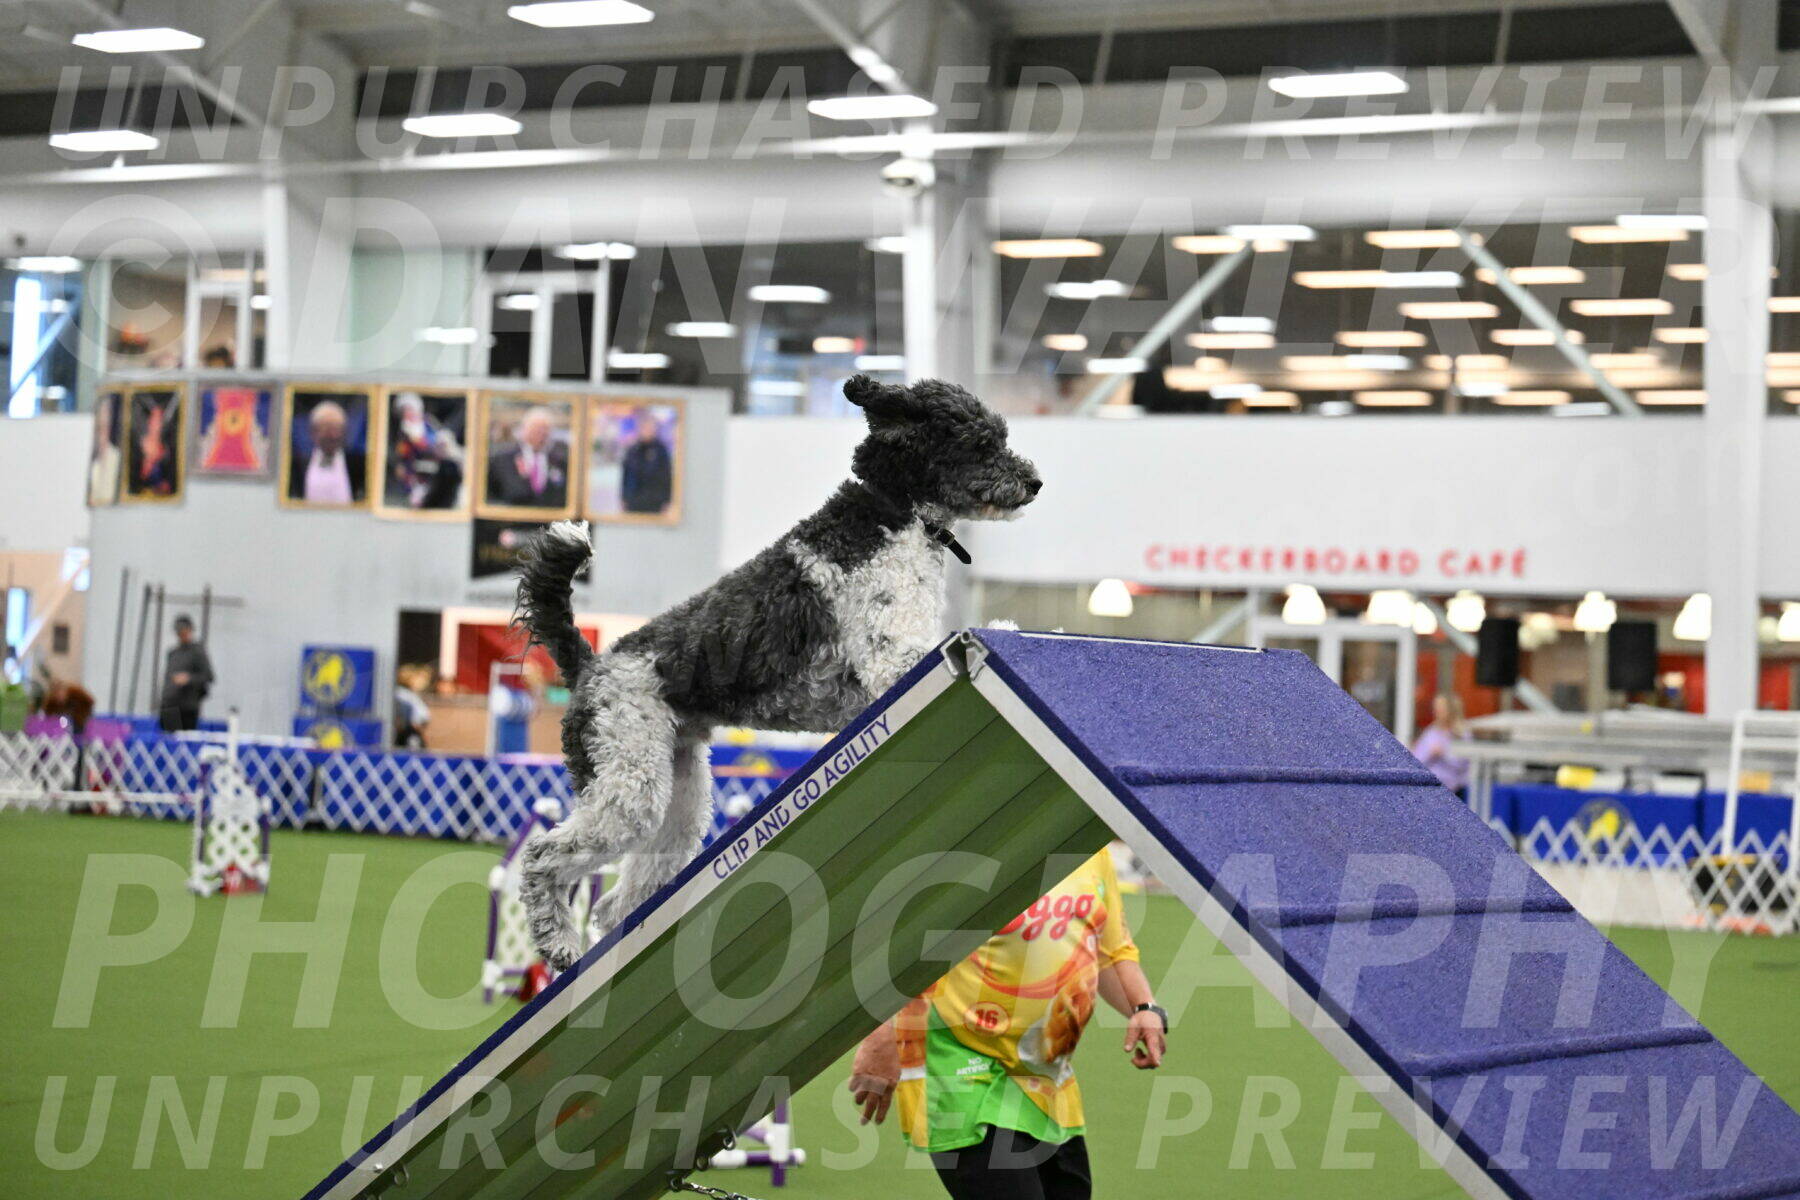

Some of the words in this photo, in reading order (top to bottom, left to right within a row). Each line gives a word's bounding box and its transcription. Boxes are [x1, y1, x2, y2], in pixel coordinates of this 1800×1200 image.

[1145, 543, 1419, 575] CHECKERBOARD
[1438, 546, 1528, 578] CAFÉ
[713, 838, 749, 879] CLIP
[755, 805, 790, 848] AND
[793, 779, 820, 811] GO
[824, 714, 891, 787] AGILITY
[976, 1009, 999, 1029] 16
